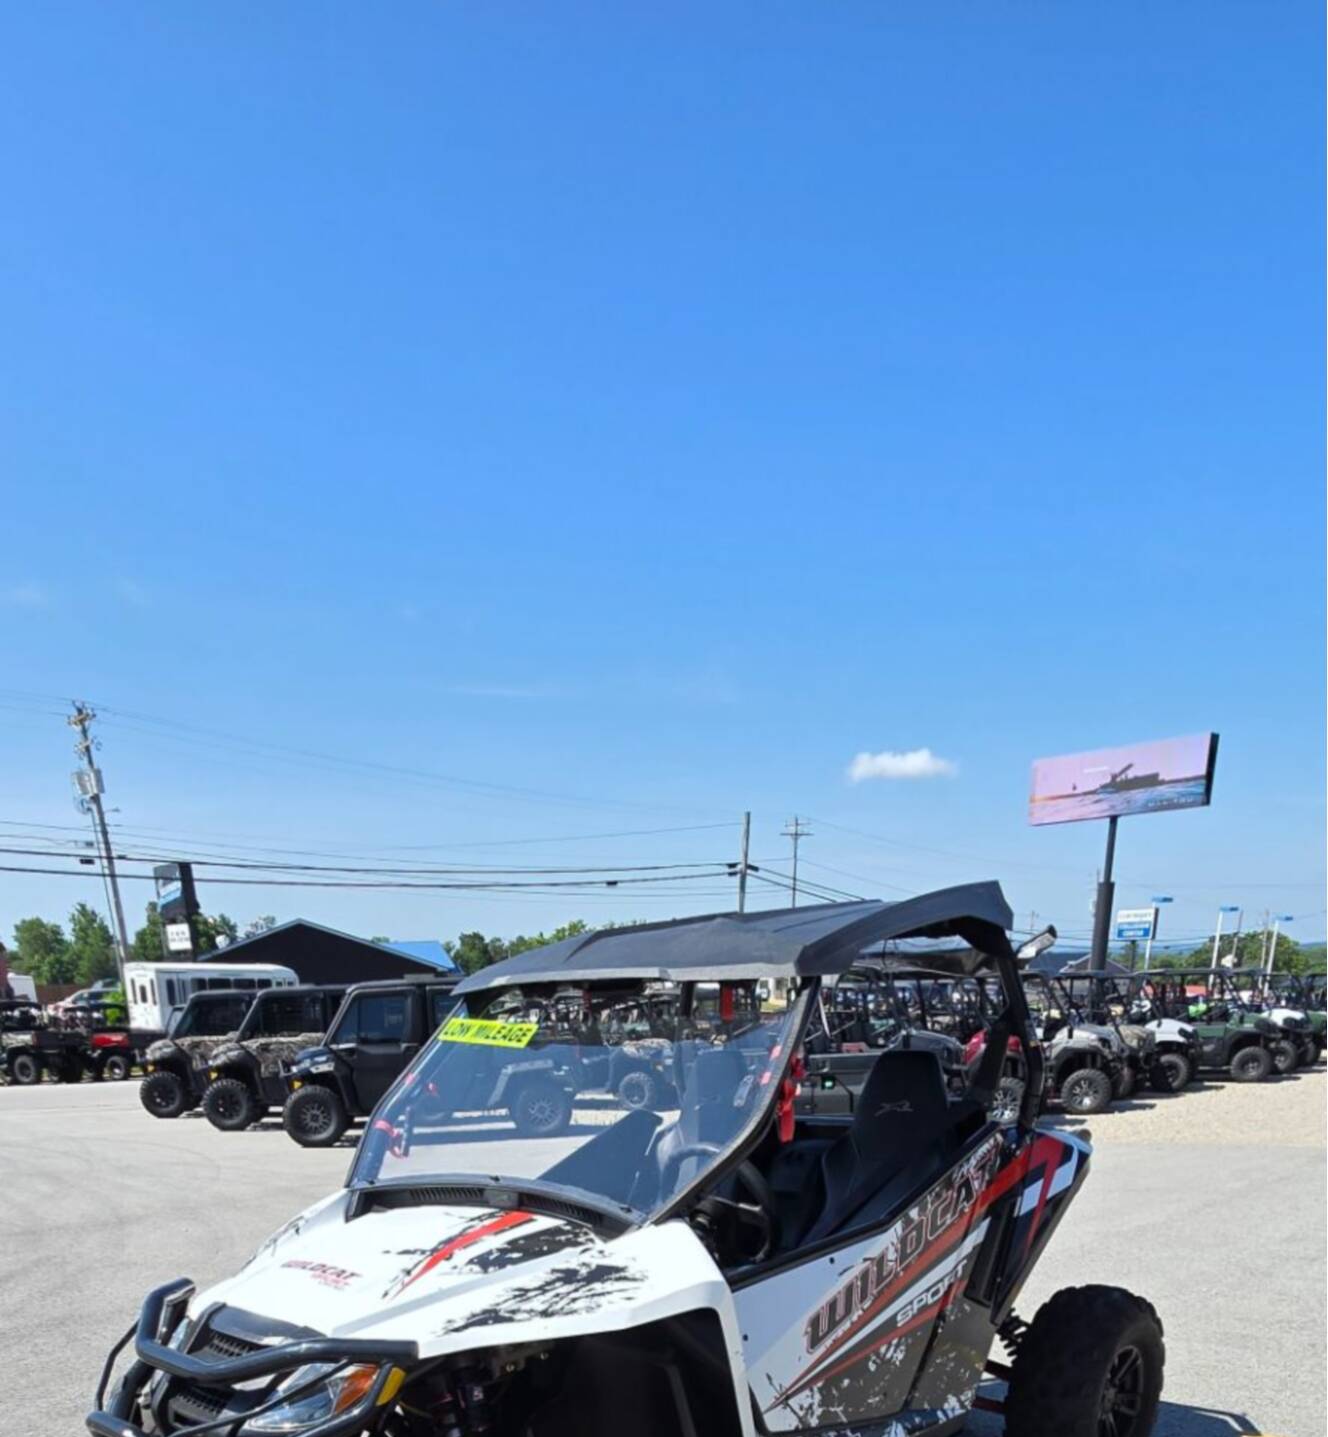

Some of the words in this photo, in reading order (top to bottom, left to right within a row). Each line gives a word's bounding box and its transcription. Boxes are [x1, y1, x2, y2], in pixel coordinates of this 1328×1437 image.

[443, 1021, 474, 1038] LOW
[472, 1023, 533, 1043] MILEAGE
[804, 1138, 1002, 1354] WILDCAT
[896, 1259, 967, 1327] SPORT
